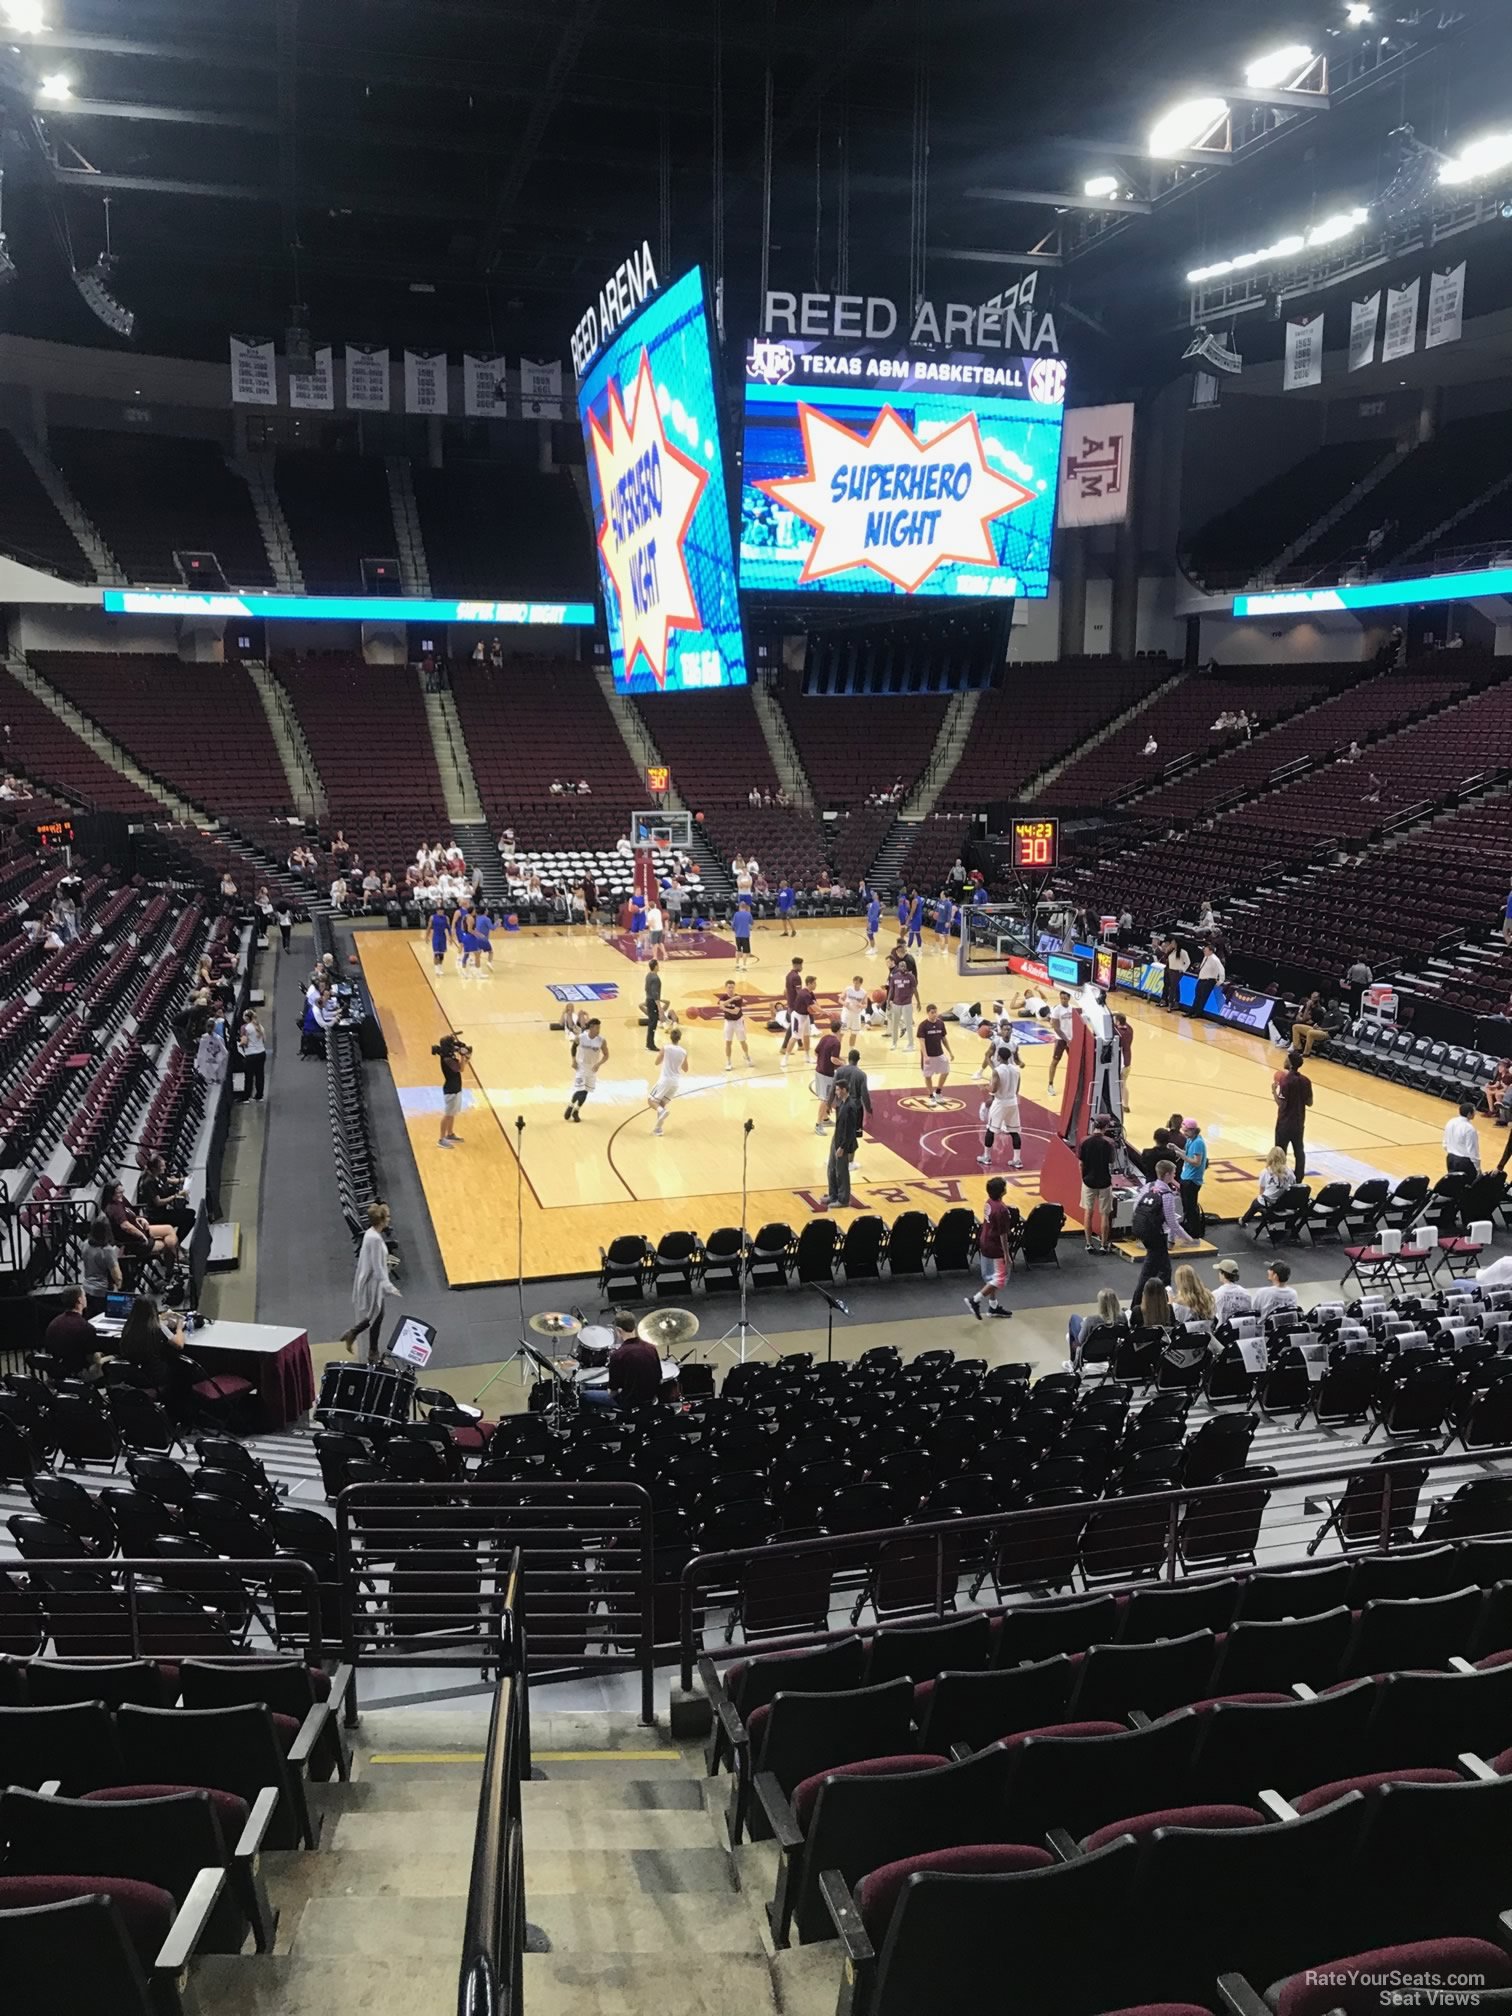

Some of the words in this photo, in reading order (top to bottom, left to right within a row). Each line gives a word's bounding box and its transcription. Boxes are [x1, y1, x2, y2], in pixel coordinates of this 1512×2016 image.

[570, 306, 598, 380] REED
[599, 240, 659, 343] ARENA
[765, 291, 897, 339] REED
[910, 301, 1059, 353] ARENA
[801, 354, 862, 375] TEXAS
[866, 359, 909, 378] A&M
[914, 361, 1023, 387] BASKETBALL
[1031, 358, 1067, 403] SEC
[610, 440, 663, 554] SUPERHERO
[831, 462, 972, 503] SUPERHERO
[864, 509, 942, 549] NIGHT
[629, 537, 660, 620] NIGHT
[651, 775, 665, 789] 30
[1016, 823, 1052, 837] 44:23
[1021, 839, 1047, 862] 30
